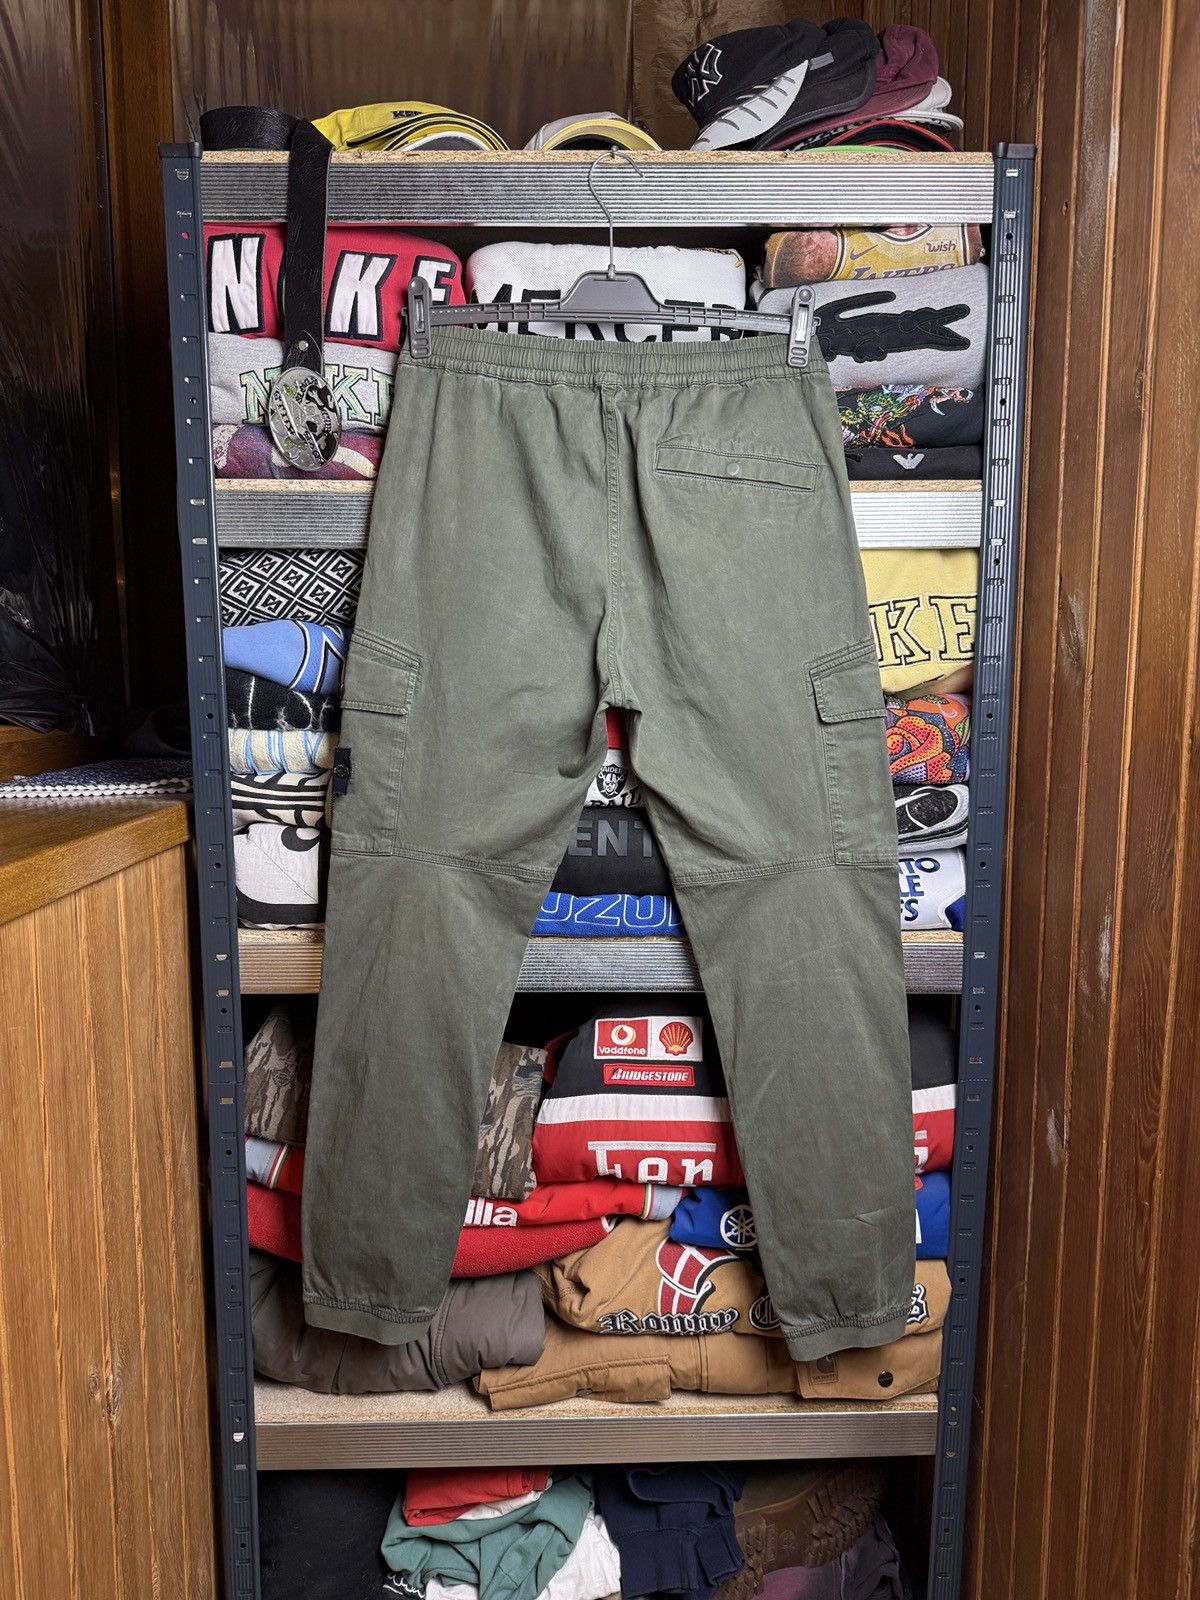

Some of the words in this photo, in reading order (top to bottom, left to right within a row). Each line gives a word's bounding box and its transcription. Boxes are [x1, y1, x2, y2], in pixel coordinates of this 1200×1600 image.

[926, 241, 956, 253] wish
[207, 233, 458, 342] NKE
[239, 363, 396, 427] NKE
[611, 1067, 689, 1082] BRIDGESTONE
[598, 1308, 740, 1335] Ronny
